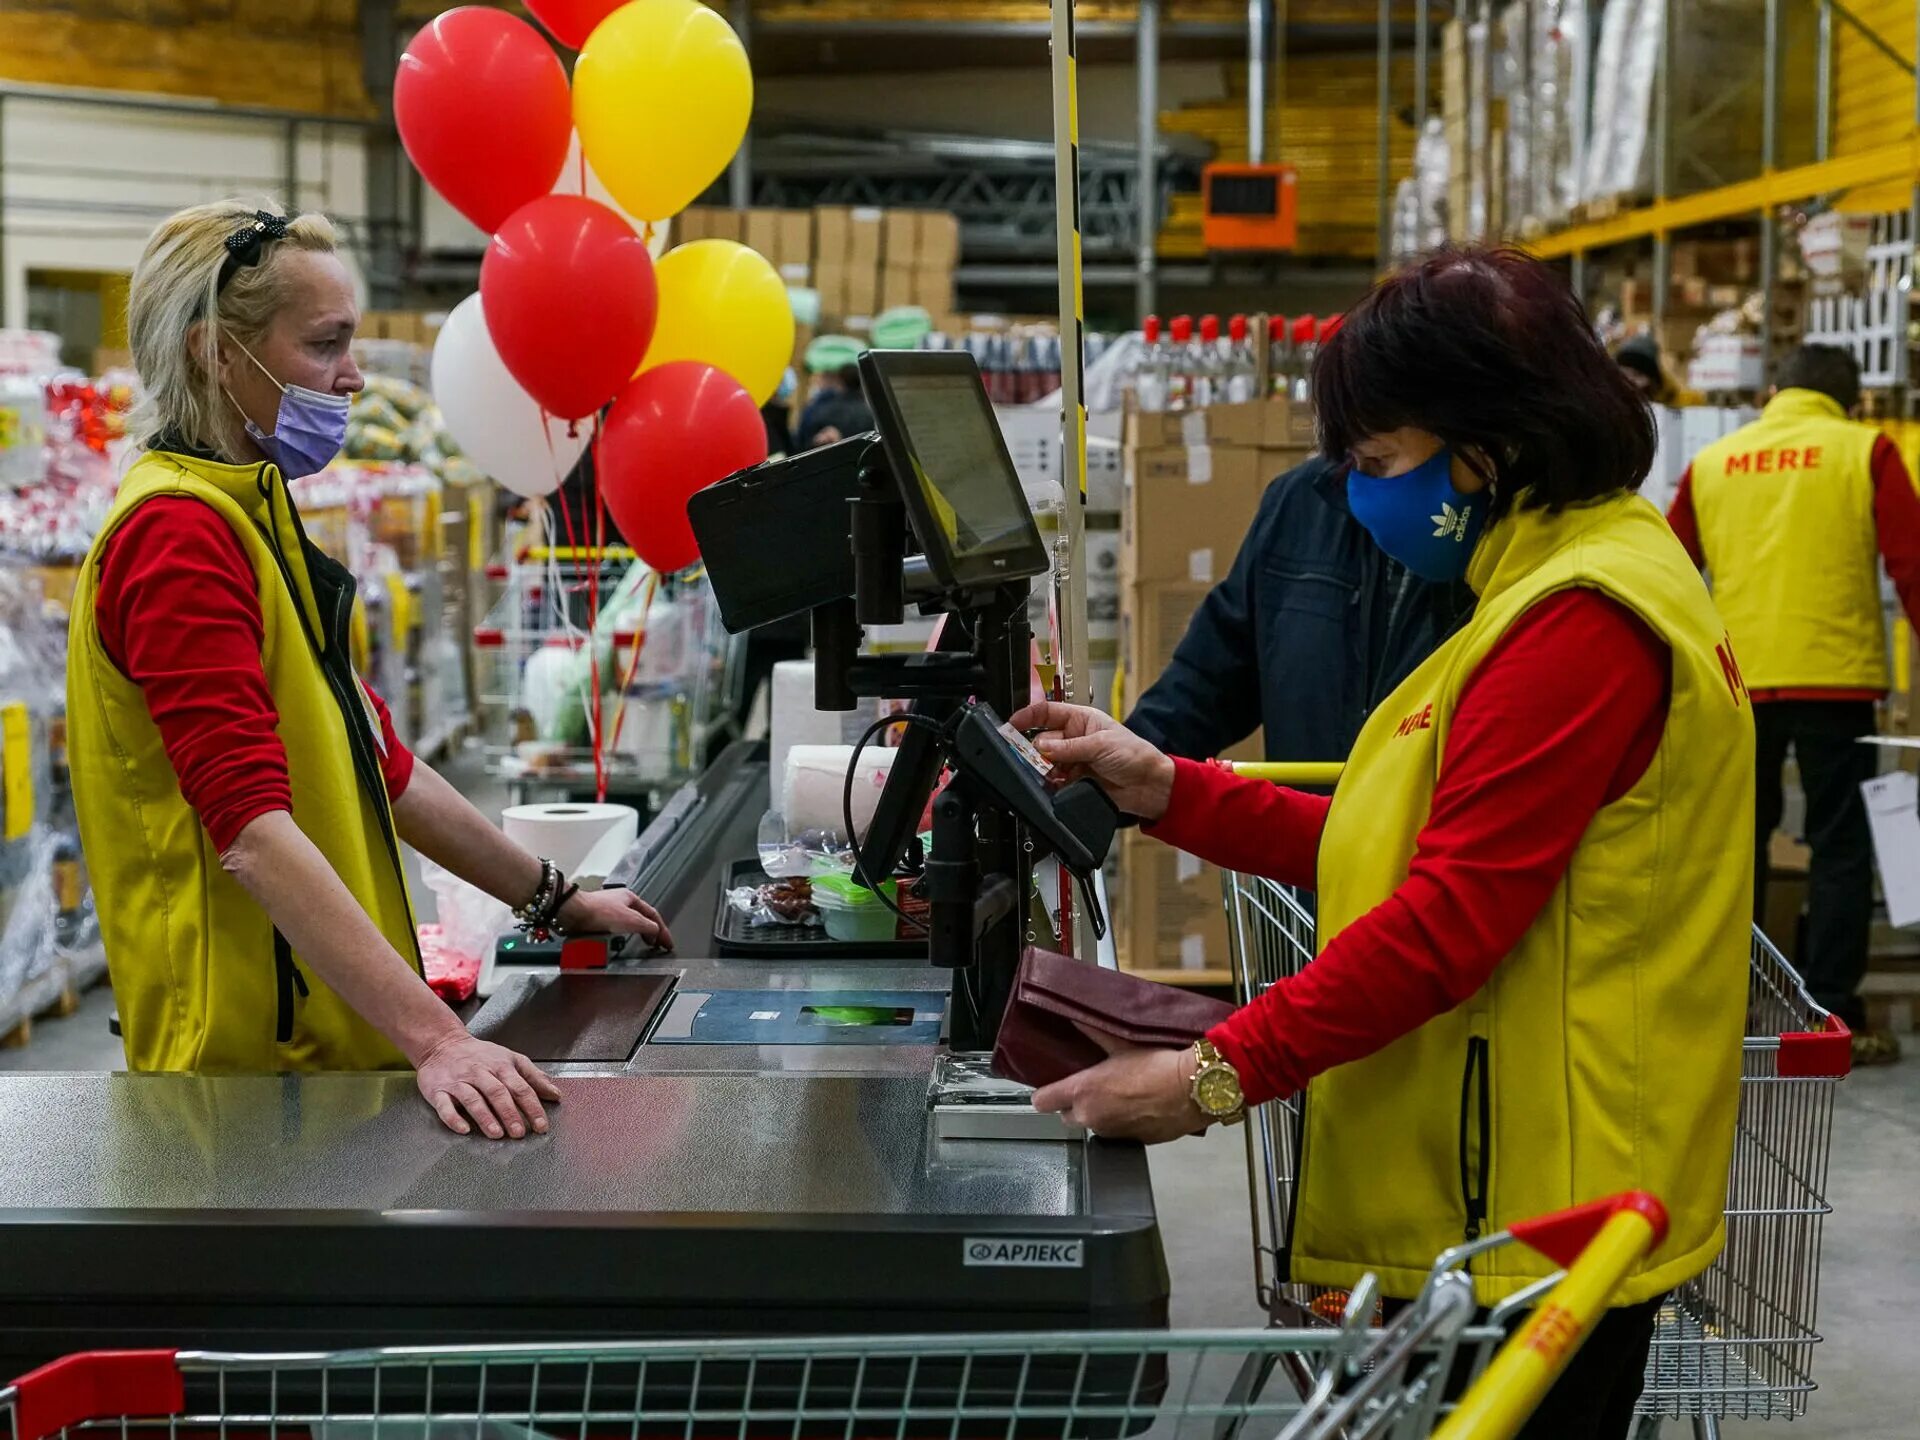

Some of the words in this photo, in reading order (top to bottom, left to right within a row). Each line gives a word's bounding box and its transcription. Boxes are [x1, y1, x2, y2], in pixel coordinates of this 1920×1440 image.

[1725, 446, 1824, 477] MERE
[1455, 505, 1472, 542] adidas
[1393, 703, 1433, 739] MERE
[994, 1243, 1078, 1263] АРЛЕКС
